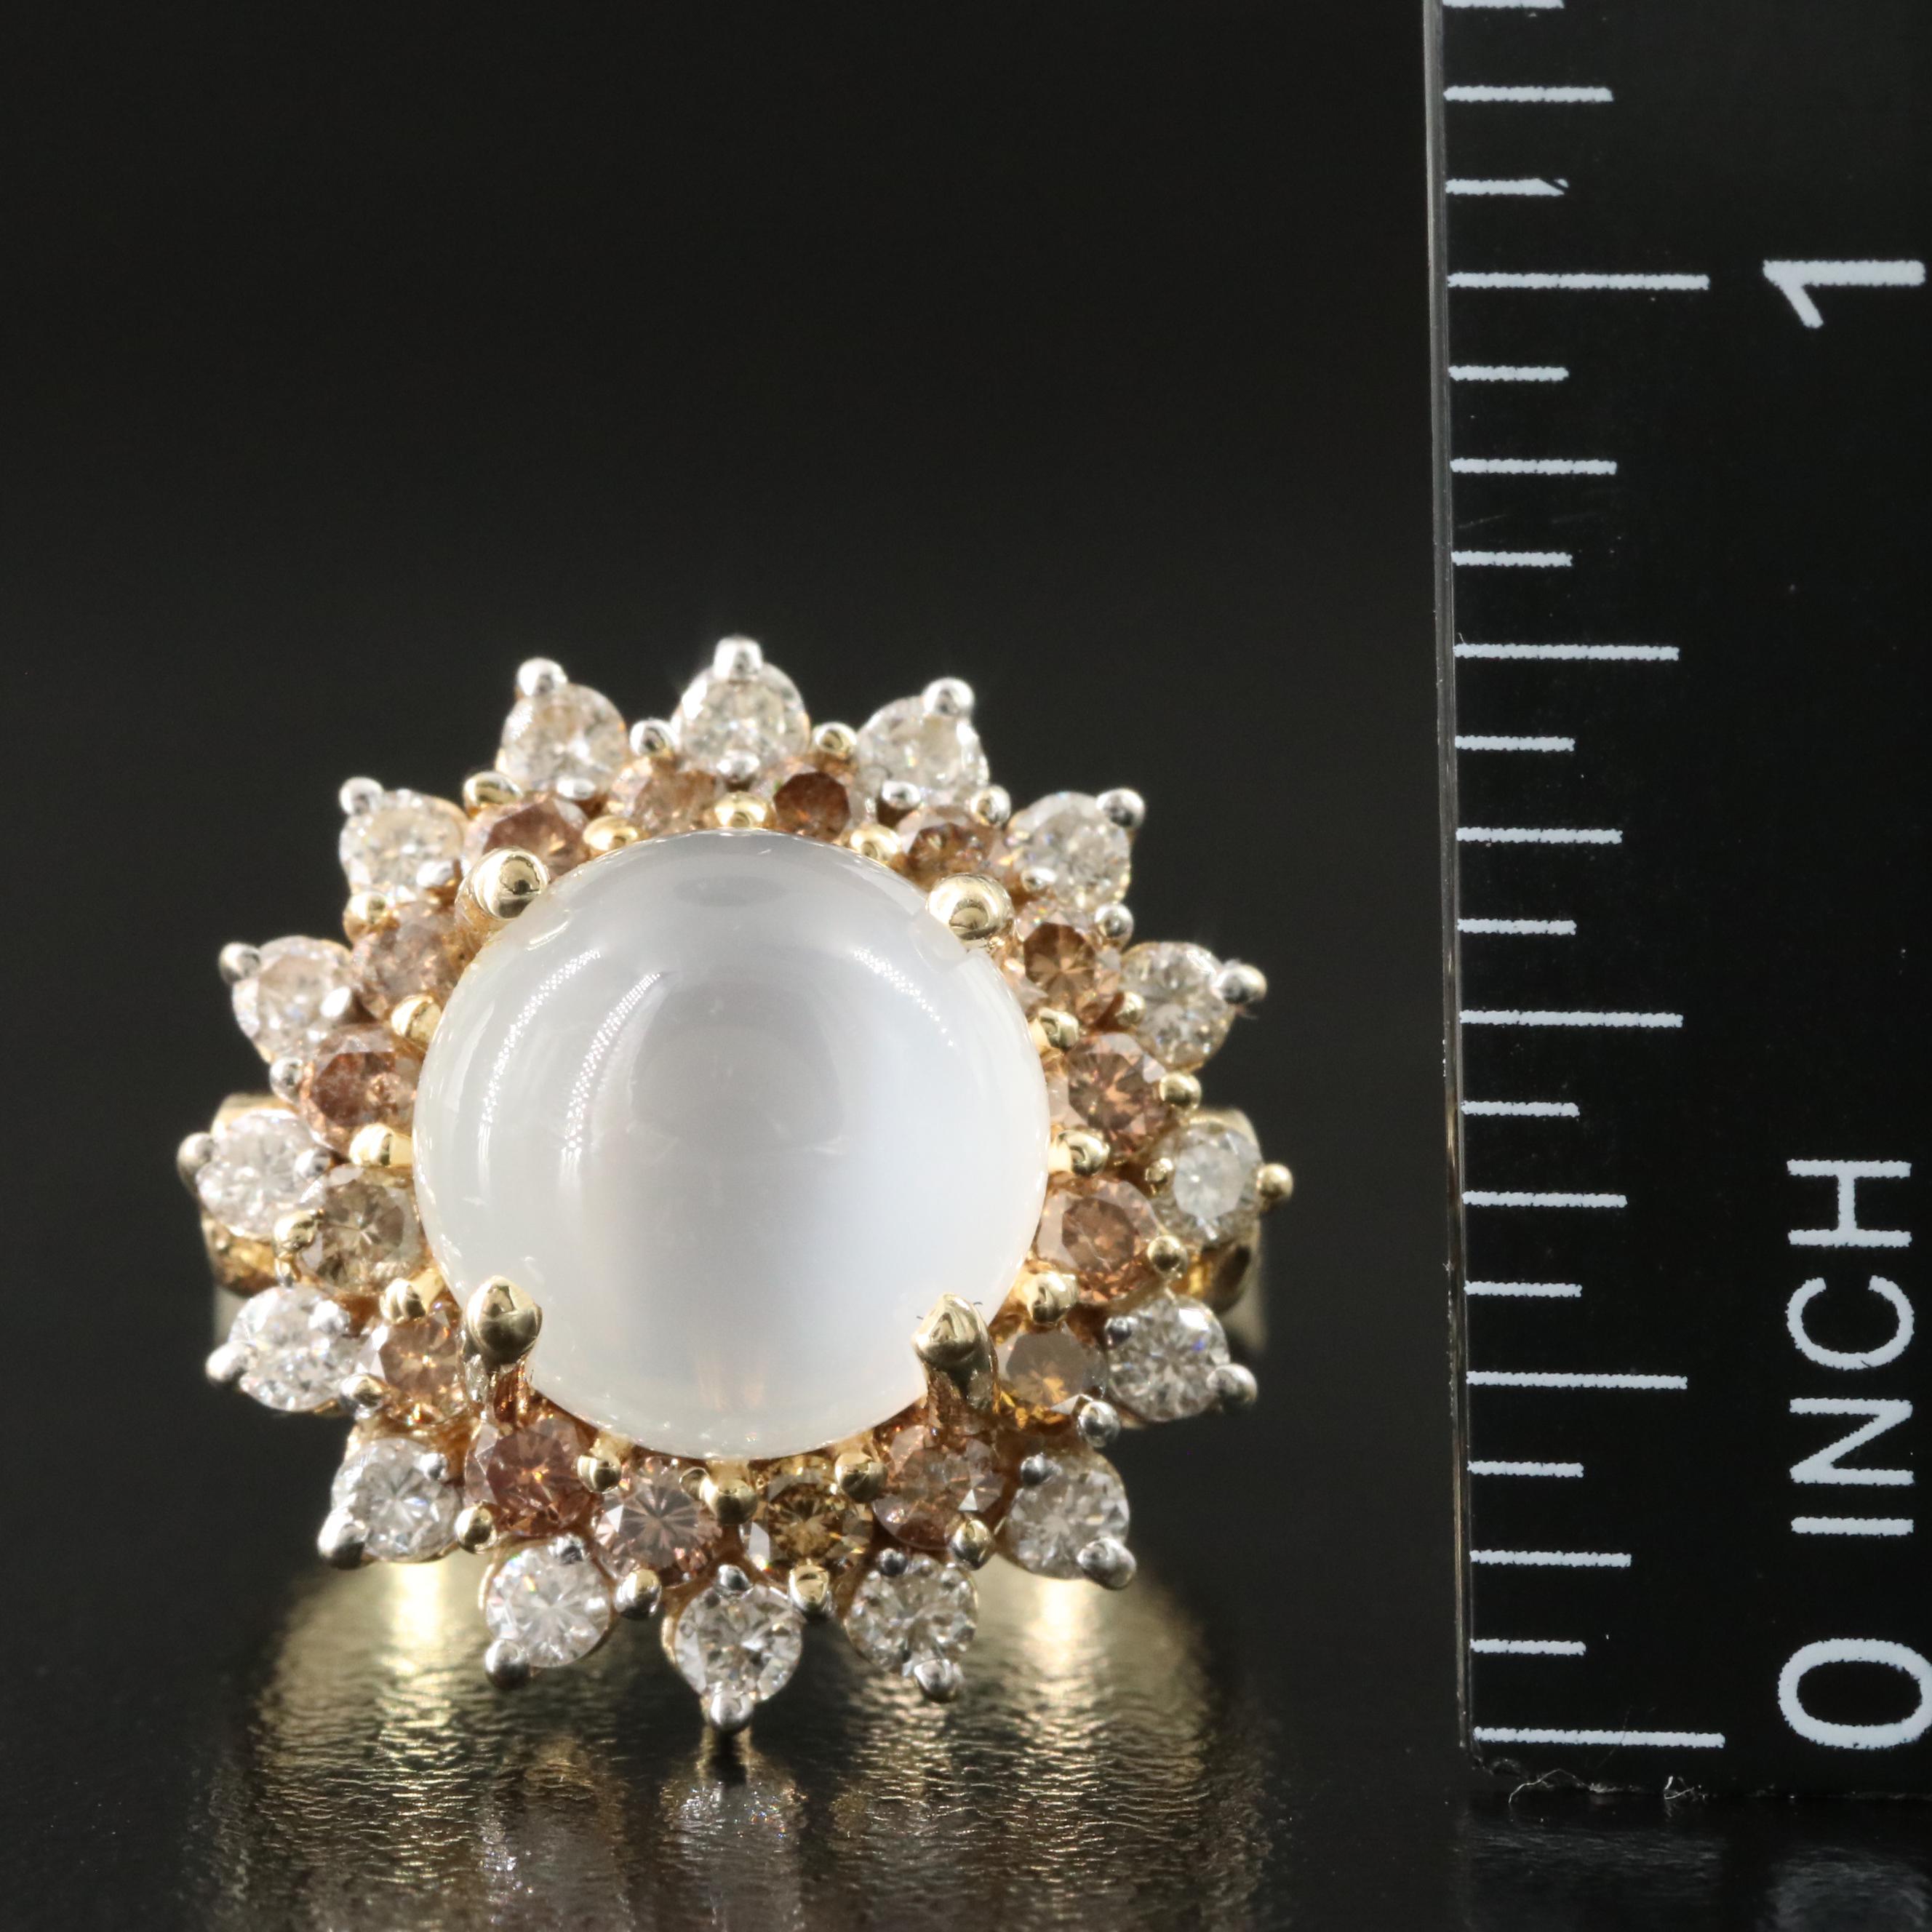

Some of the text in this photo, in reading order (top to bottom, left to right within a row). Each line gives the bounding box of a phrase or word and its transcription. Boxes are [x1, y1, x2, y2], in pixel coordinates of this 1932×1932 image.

[1763, 260, 1925, 328] 1
[1778, 1159, 1932, 1749] 0 INCH
